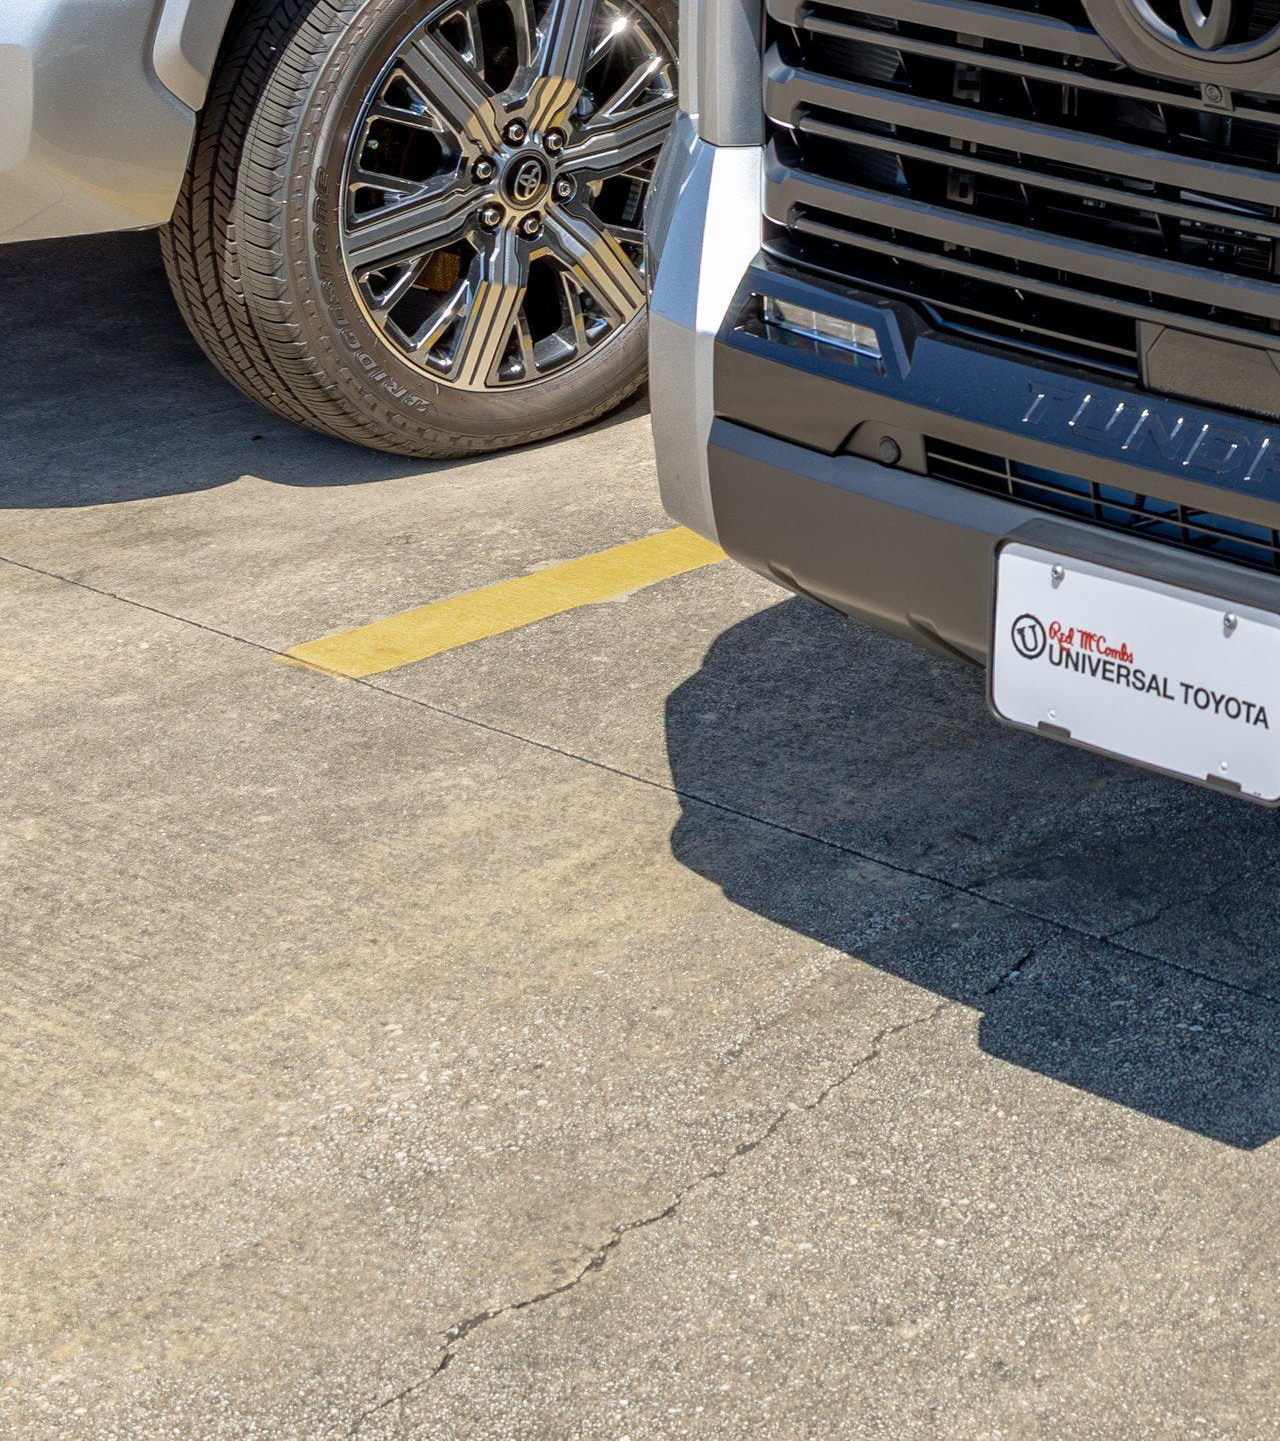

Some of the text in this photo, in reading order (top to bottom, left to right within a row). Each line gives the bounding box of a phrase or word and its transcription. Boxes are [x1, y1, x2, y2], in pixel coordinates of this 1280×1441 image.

[312, 166, 431, 413] BRIDGESTONE
[1049, 621, 1133, 664] Red McCombs
[1049, 644, 1269, 729] UNIVERSAL TOYOTA
